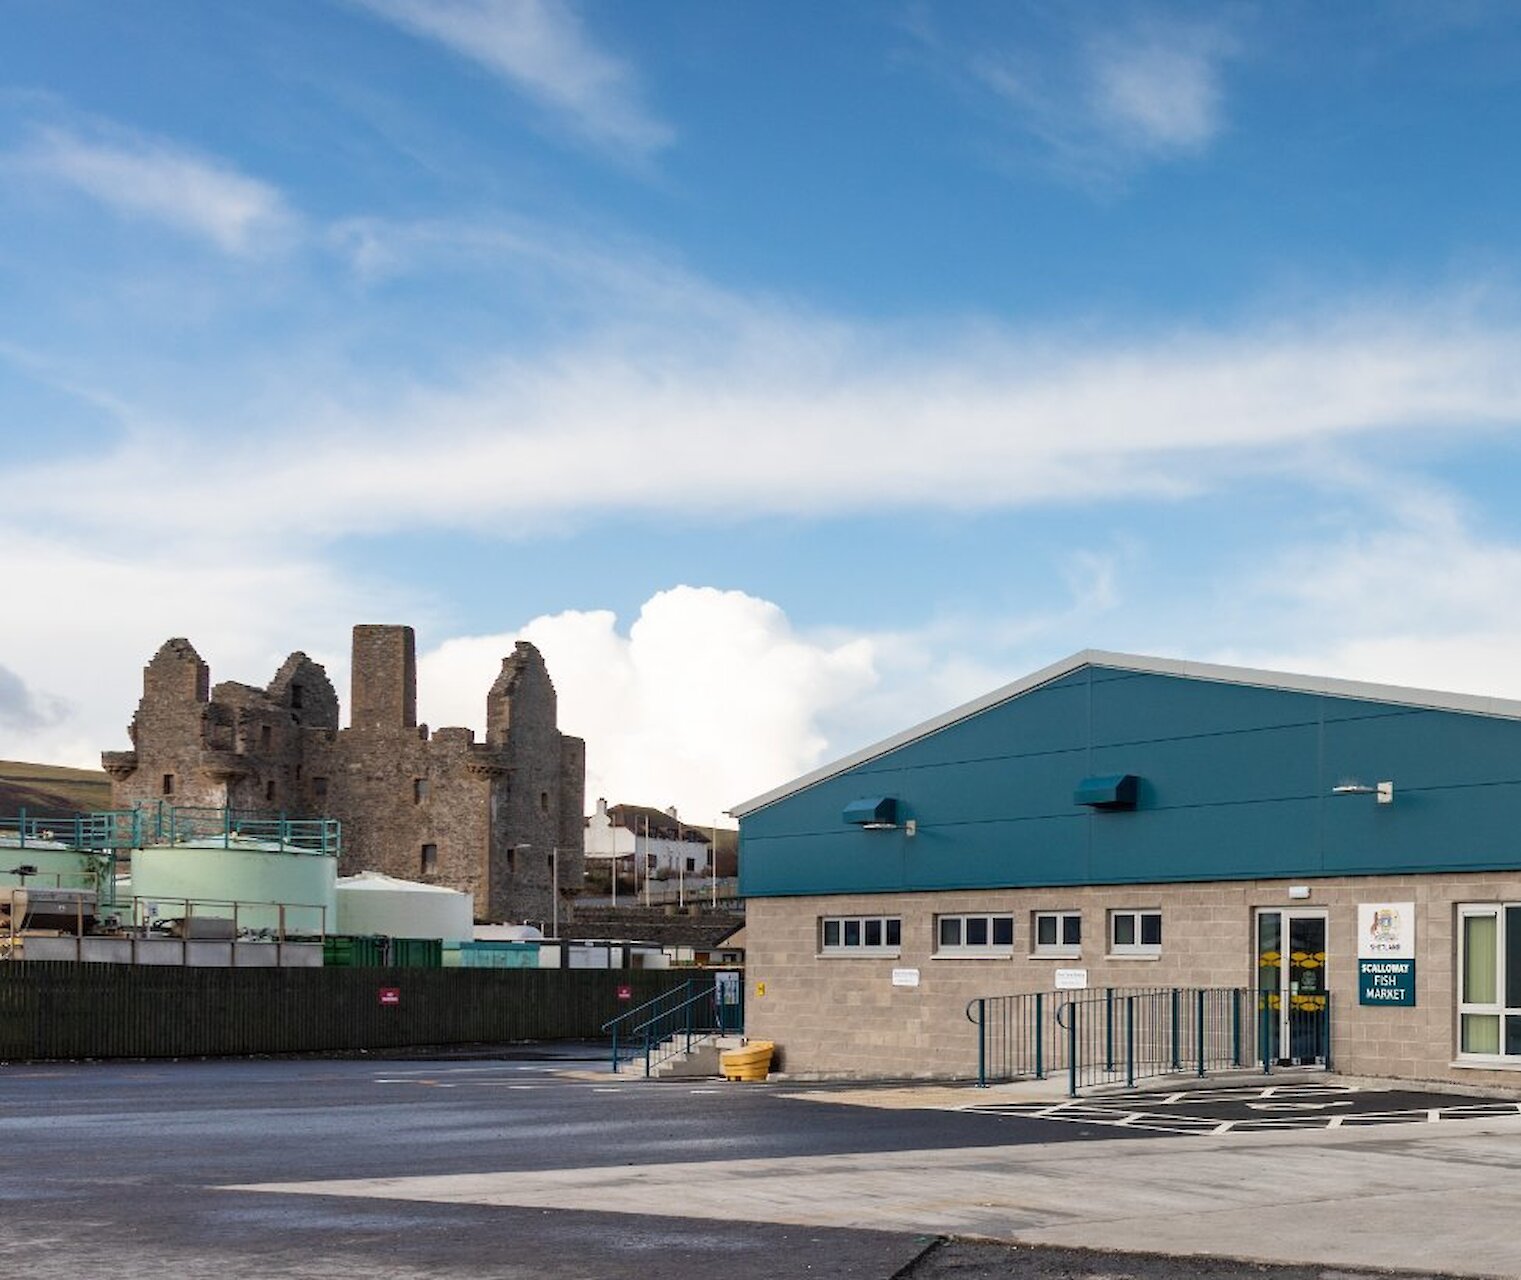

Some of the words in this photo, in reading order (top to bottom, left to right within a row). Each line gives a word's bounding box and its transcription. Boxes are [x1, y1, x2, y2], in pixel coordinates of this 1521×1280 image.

[1361, 963, 1409, 974] SCALLOWAY
[1374, 974, 1397, 986] FISH
[1366, 987, 1405, 1000] MARKET
